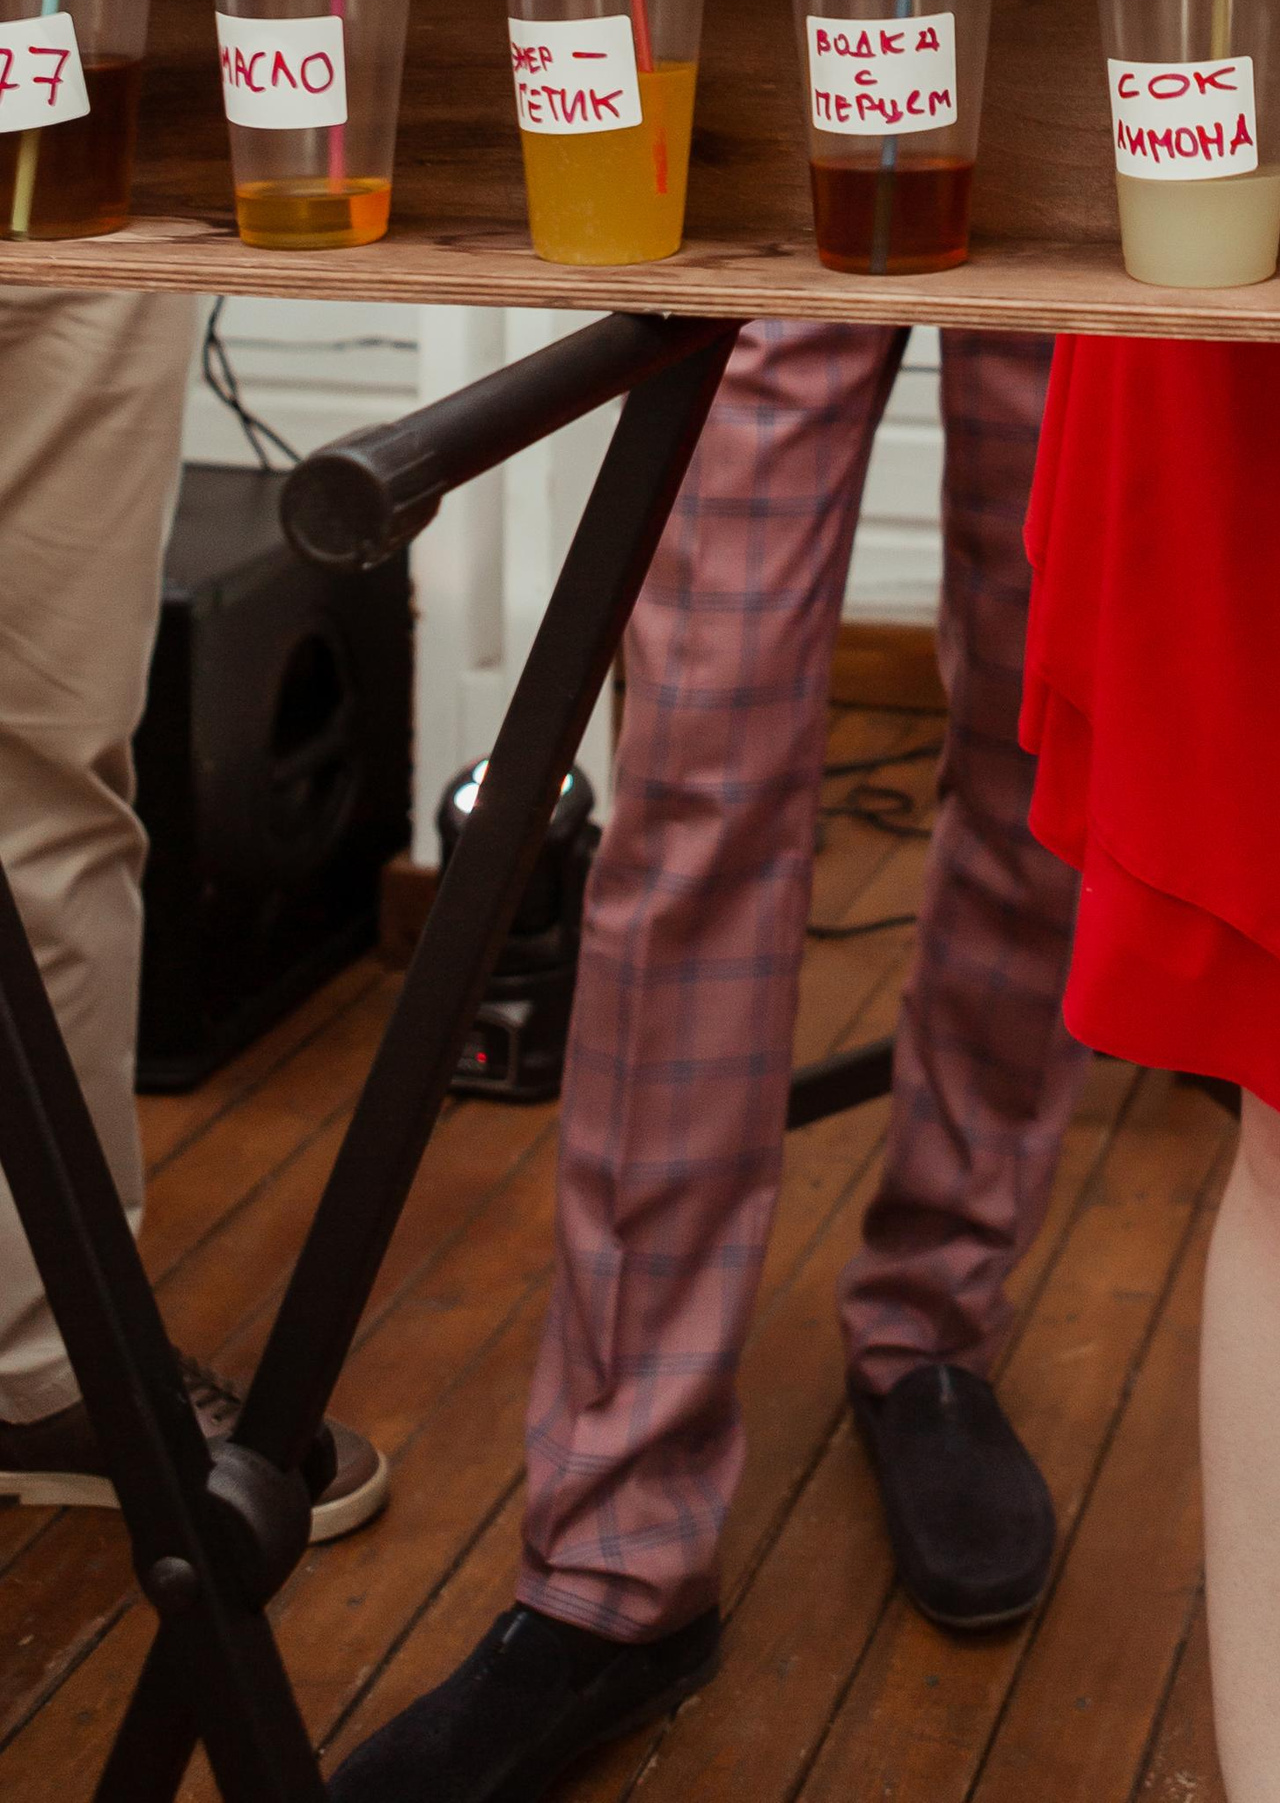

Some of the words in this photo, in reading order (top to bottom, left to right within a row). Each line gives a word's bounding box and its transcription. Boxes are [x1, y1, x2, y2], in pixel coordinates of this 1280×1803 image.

[816, 27, 940, 58] ВОДКА
[221, 46, 334, 94] МАСЛО
[1118, 66, 1238, 99] СОК
[1117, 112, 1254, 164] ЛИМОНА
